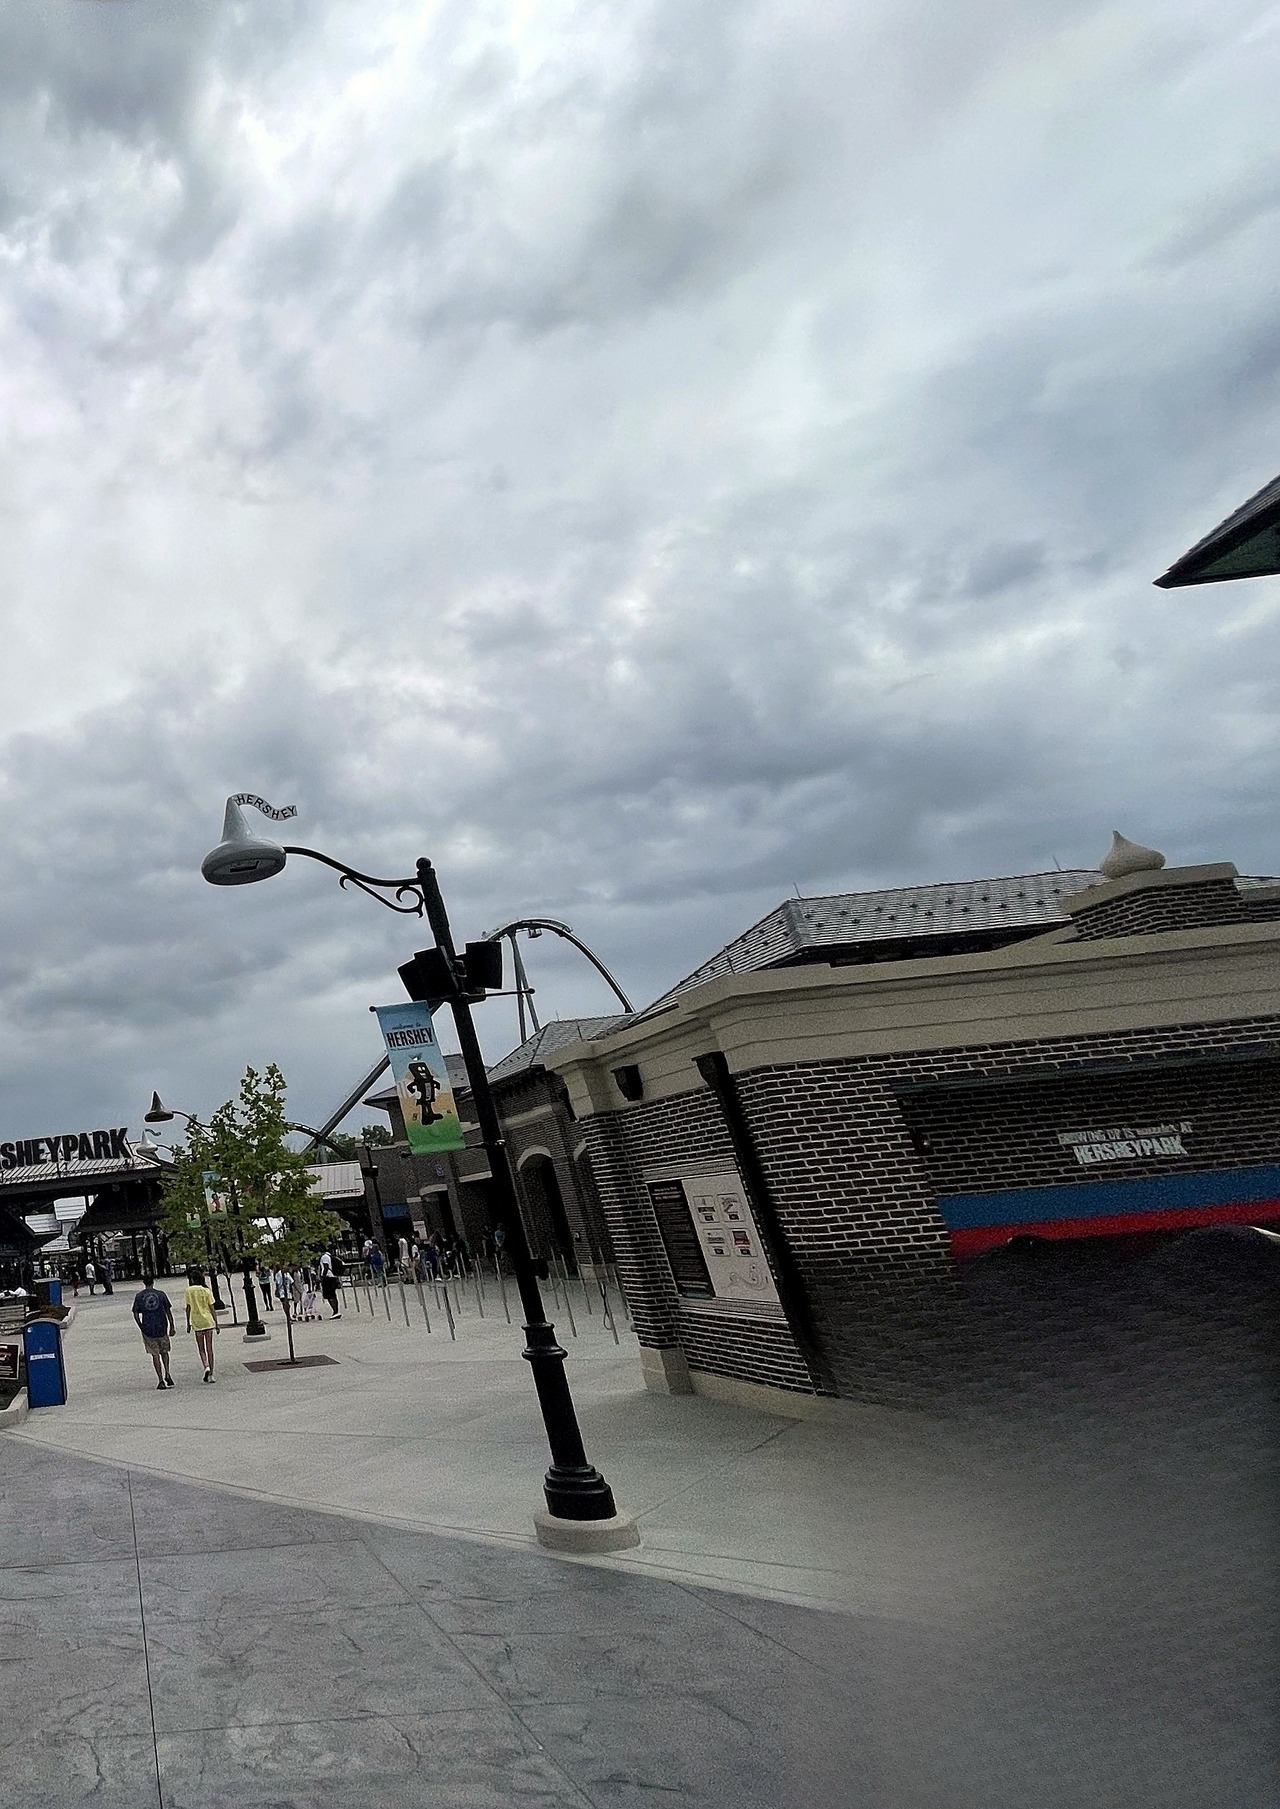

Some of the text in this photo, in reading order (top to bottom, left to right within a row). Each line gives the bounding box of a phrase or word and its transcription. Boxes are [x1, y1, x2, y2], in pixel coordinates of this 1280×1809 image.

[236, 794, 295, 819] HERSHEY
[386, 1027, 434, 1048] HERSHEY
[1073, 1135, 1188, 1165] HERSHEYPARK
